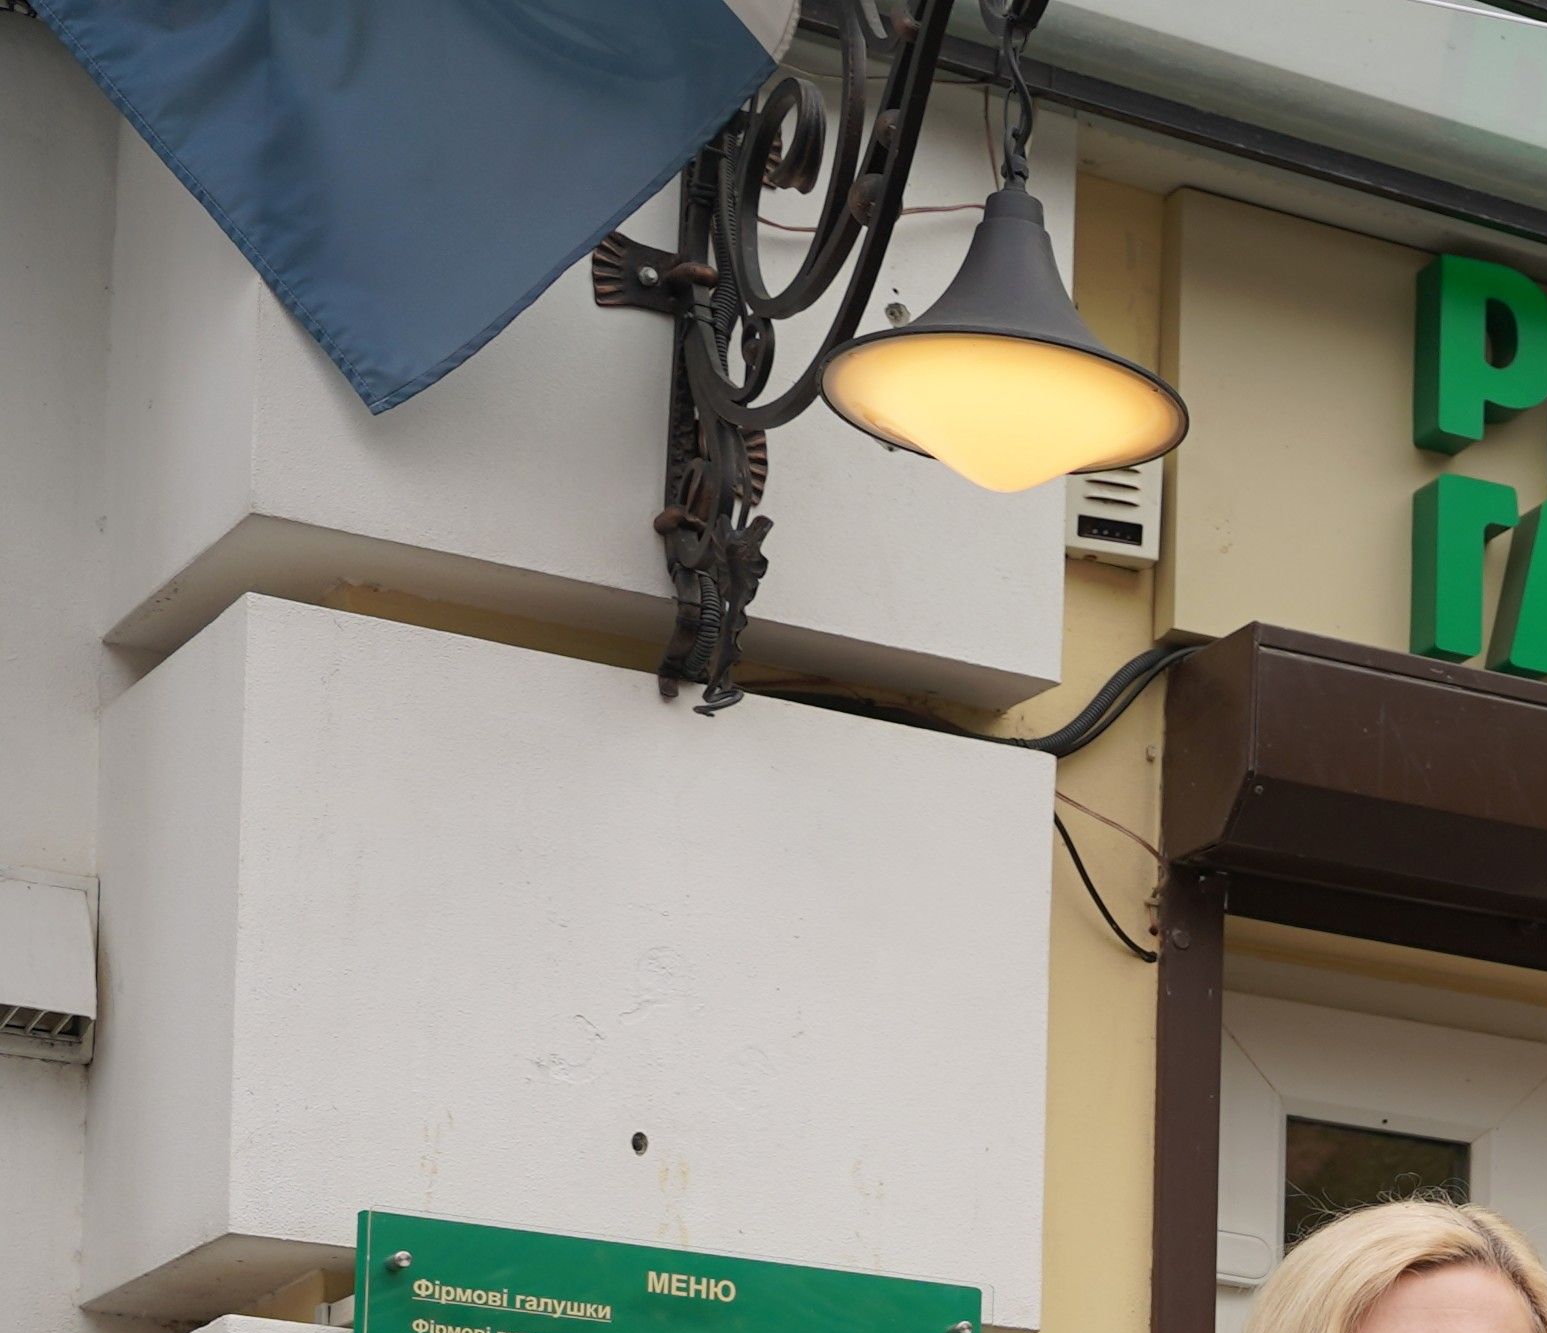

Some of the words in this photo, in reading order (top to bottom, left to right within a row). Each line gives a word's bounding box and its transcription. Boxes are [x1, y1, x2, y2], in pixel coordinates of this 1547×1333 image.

[413, 1278, 508, 1307] Фірмові
[516, 1294, 611, 1320] галушки
[648, 1271, 736, 1302] МЕНЮ
